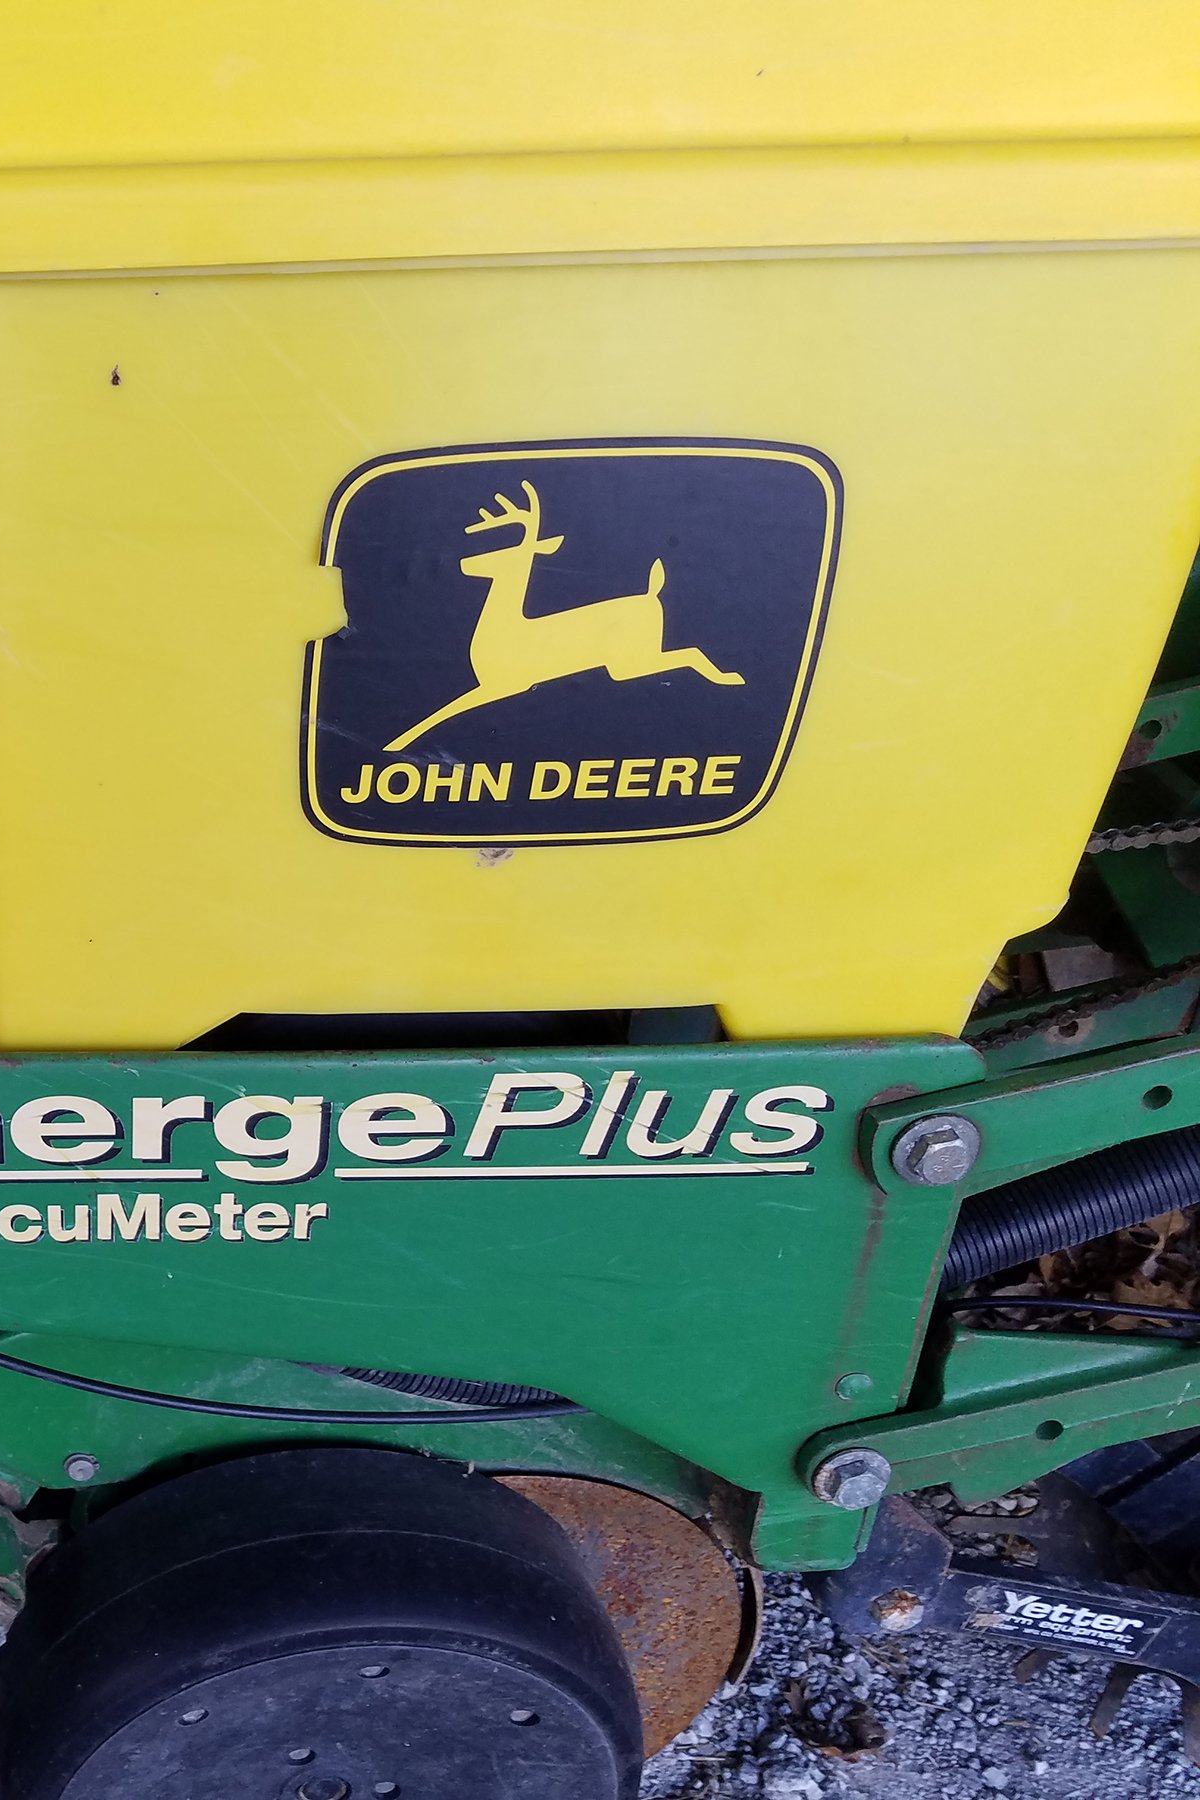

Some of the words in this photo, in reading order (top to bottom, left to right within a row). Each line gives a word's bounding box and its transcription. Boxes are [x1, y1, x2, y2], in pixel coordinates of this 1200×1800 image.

[340, 761, 513, 804] JOHN
[528, 755, 742, 801] DEERE
[1003, 1590, 1145, 1633] Yetter
[1037, 1620, 1136, 1644] equipment
